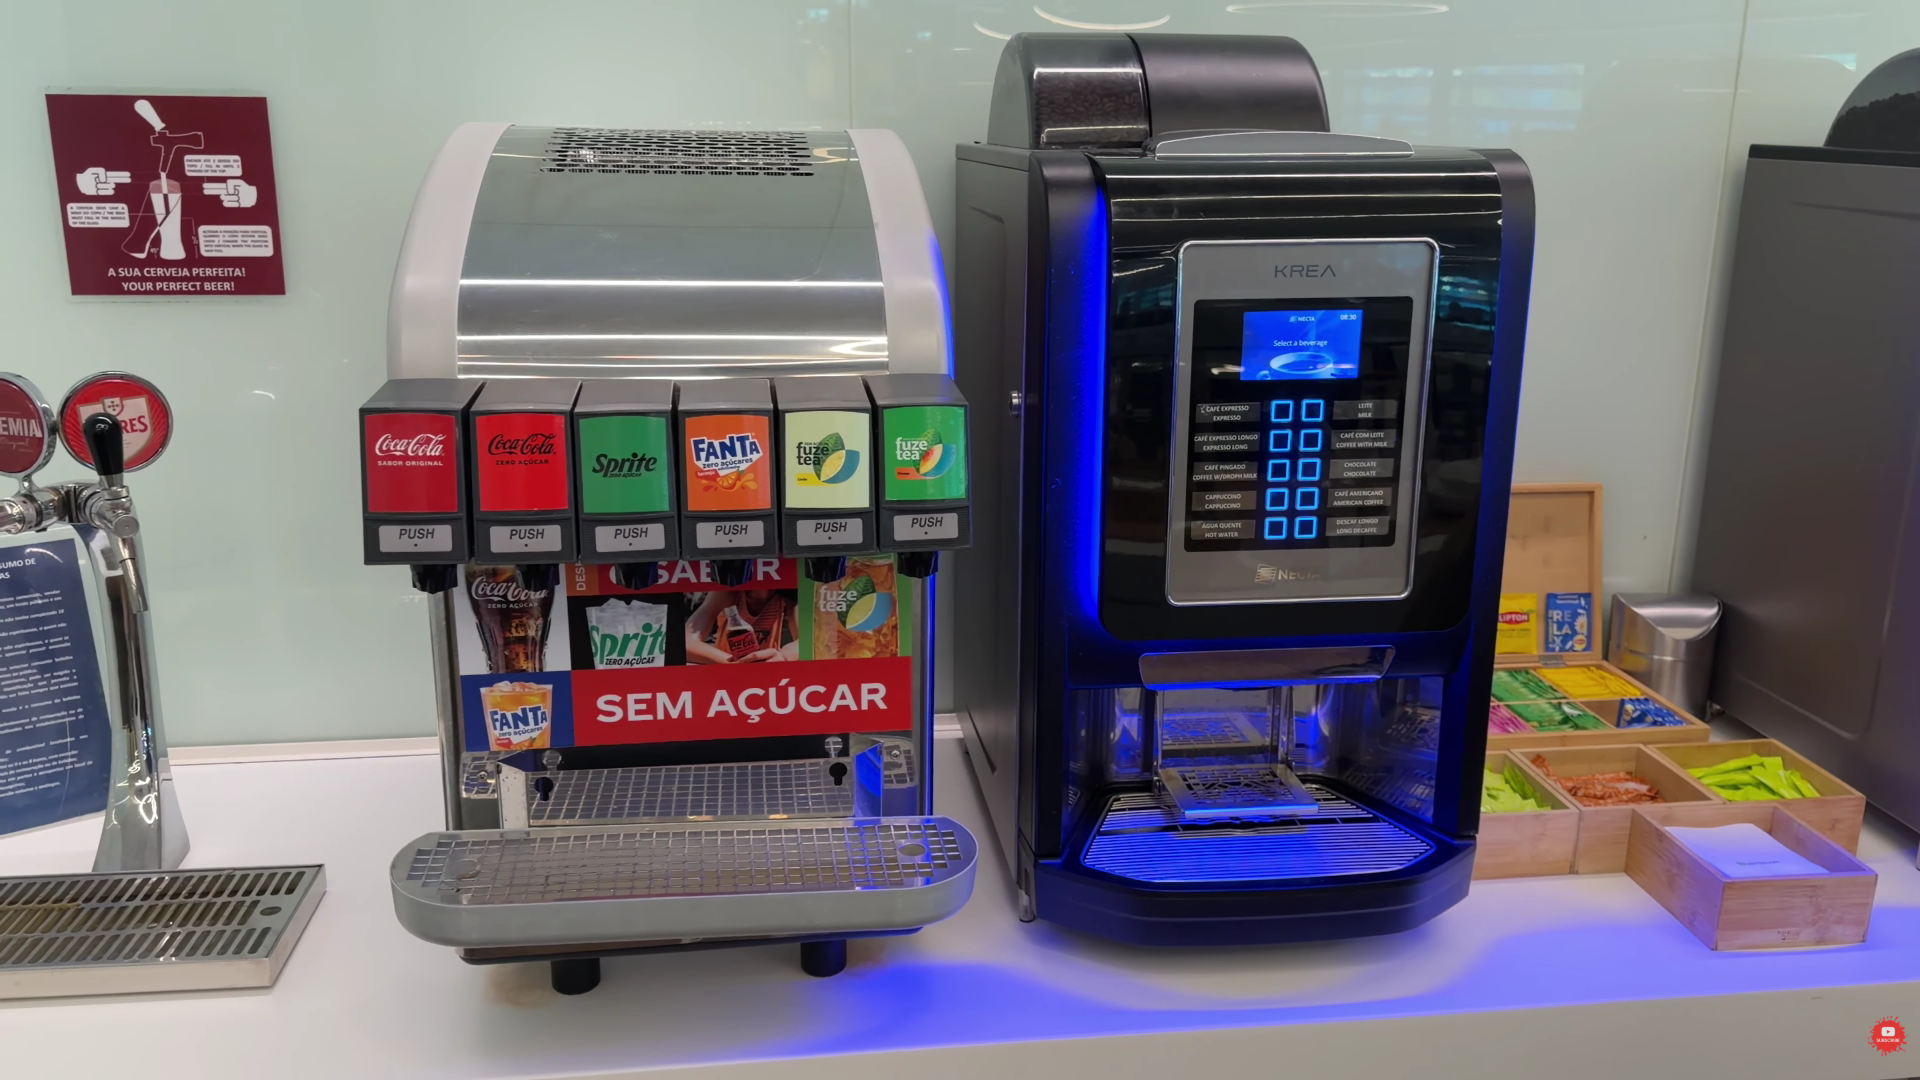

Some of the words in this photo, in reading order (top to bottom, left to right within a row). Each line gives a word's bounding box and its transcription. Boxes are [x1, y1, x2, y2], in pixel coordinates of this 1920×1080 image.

[108, 268, 116, 276] A
[118, 268, 141, 276] SUA
[144, 268, 190, 276] CERVEJA
[192, 267, 246, 276] PERFEITA!
[1275, 265, 1336, 278] KREA
[122, 282, 154, 291] YOUR
[156, 282, 201, 291] PERFECT
[204, 282, 234, 291] BEER!
[120, 415, 148, 433] RES
[375, 434, 446, 456] Coca-Cola
[488, 433, 557, 455] Coca-Cola
[693, 435, 760, 462] FANTA
[796, 442, 829, 455] fuze
[895, 437, 928, 450] fuze
[796, 455, 821, 465] tea
[896, 450, 919, 460] tea
[592, 452, 657, 478] Sprite
[721, 458, 753, 467] açúcares
[814, 522, 847, 533] PUSH
[911, 517, 943, 528] PUSH
[399, 528, 435, 539] PUSH
[509, 528, 545, 540] PUSH
[614, 527, 648, 539] PUSH
[715, 525, 748, 535] PUSH
[819, 586, 857, 601] fuze
[820, 599, 847, 612] tea
[1553, 610, 1572, 621] RE
[1553, 623, 1572, 635] LA
[1554, 636, 1563, 647] X
[624, 656, 655, 667] AÇÚCAR
[596, 691, 692, 723] SEM
[707, 678, 888, 723] AÇÚCAR
[489, 706, 548, 731] FANTA
[513, 727, 542, 736] açúcares
